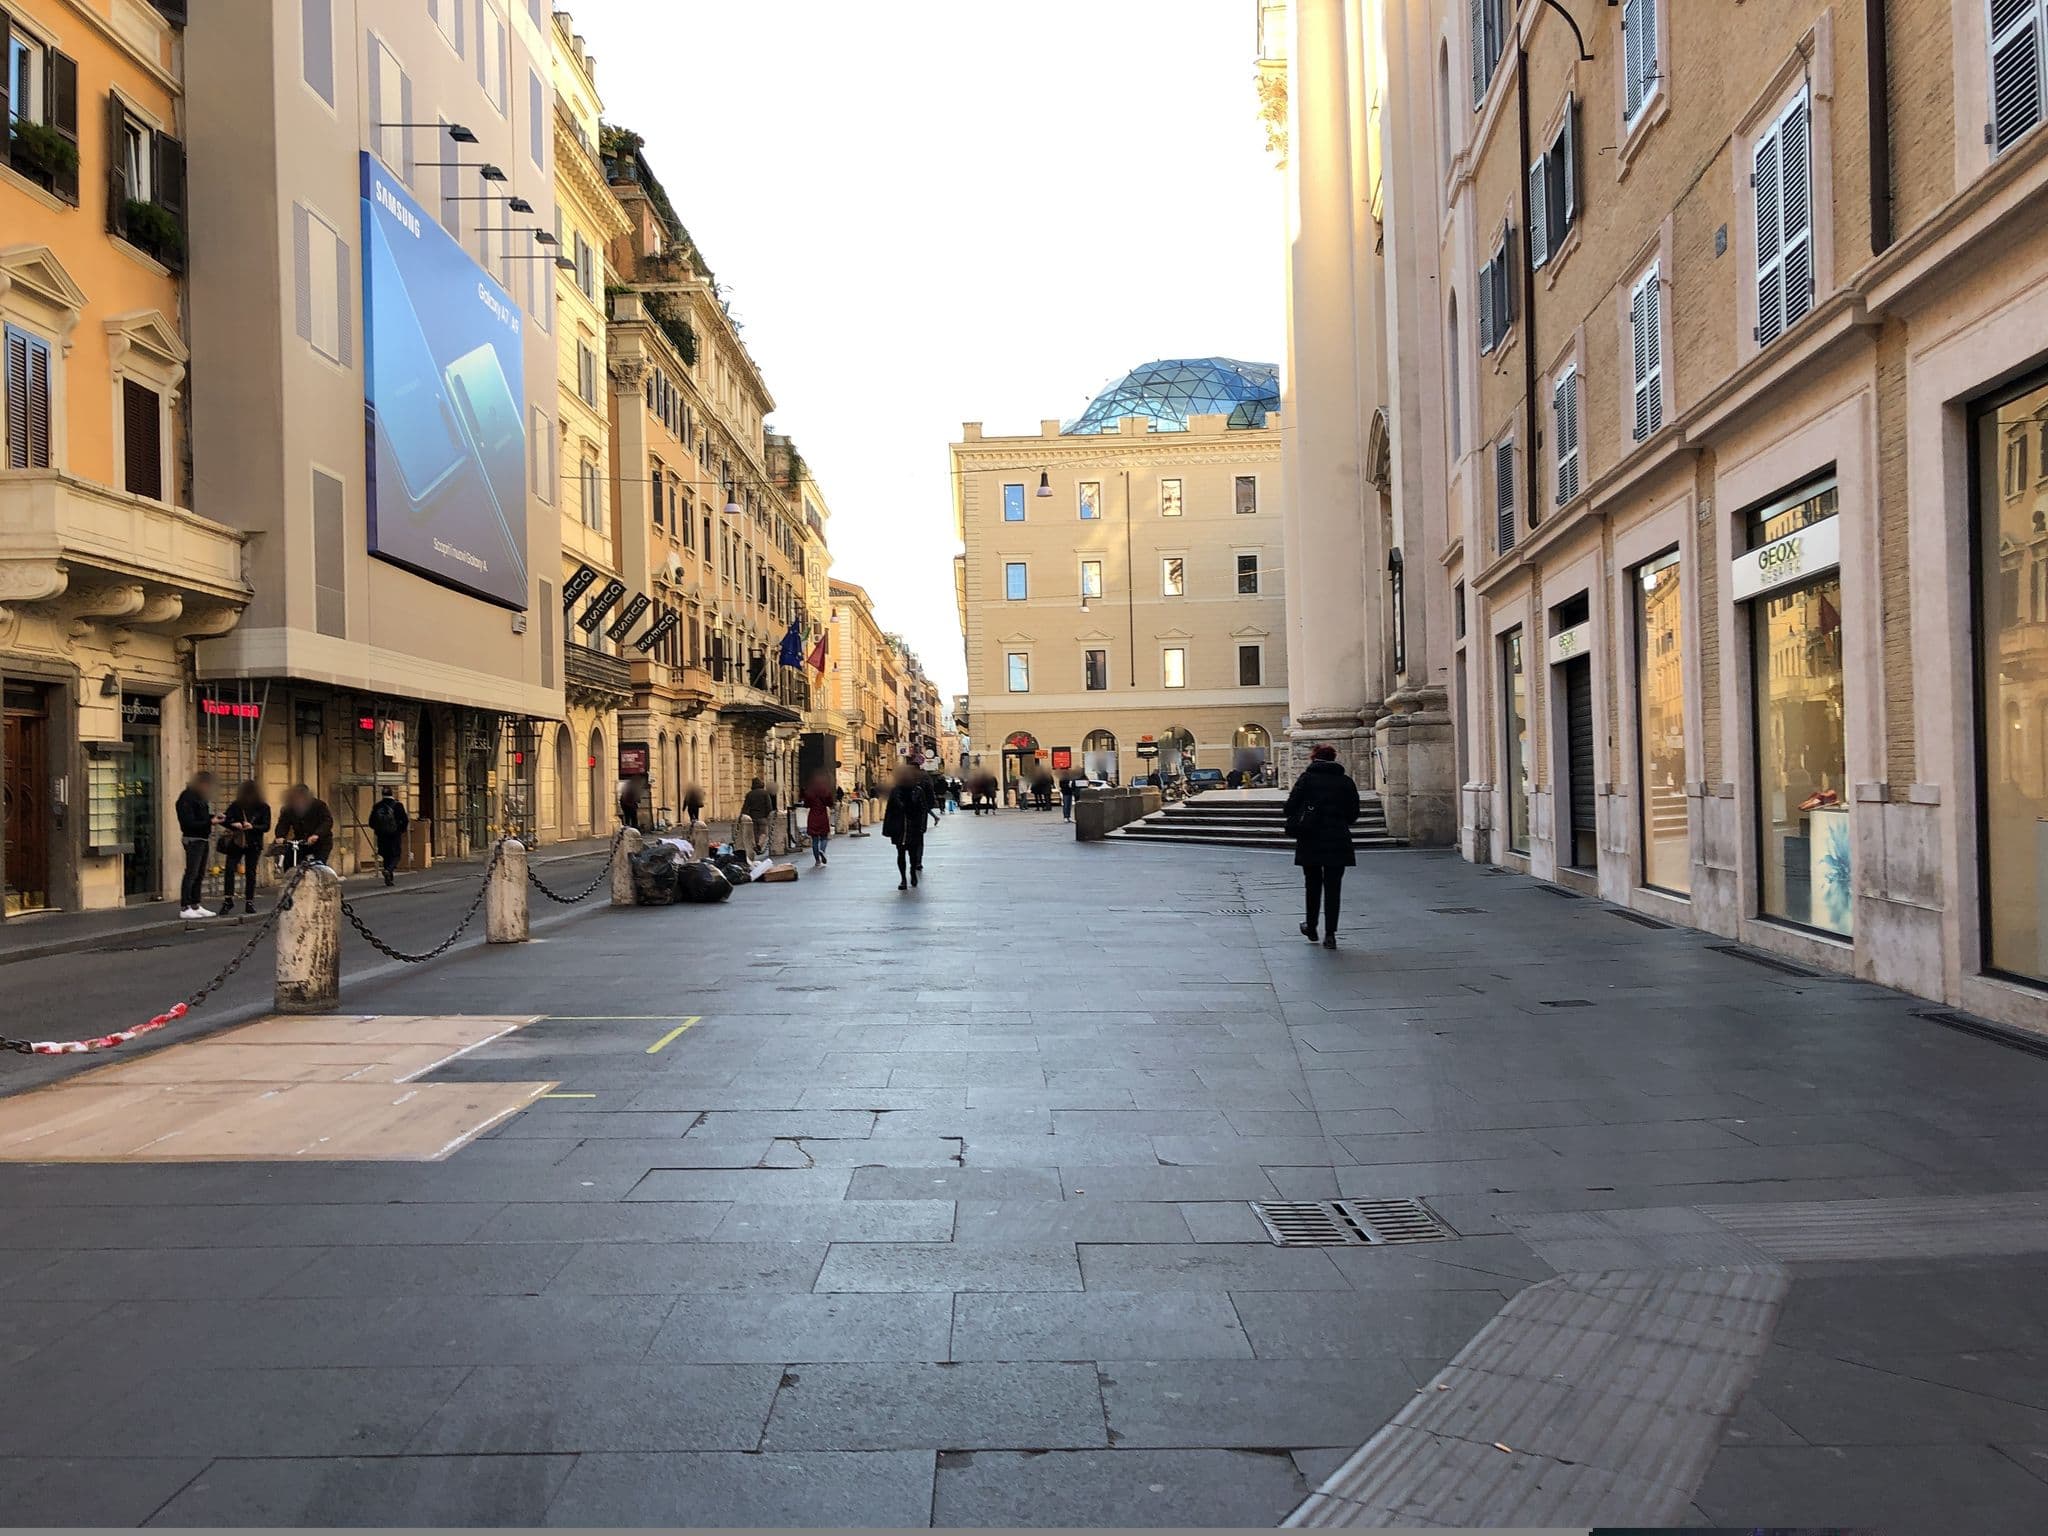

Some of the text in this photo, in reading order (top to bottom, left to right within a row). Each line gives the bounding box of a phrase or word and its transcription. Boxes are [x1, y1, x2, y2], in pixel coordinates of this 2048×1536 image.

[375, 180, 421, 239] SAMSUNG
[478, 282, 501, 321] Galaxy
[1758, 537, 1798, 569] GEOX
[583, 583, 622, 629] GUESS
[611, 597, 647, 639] GUESS
[637, 614, 676, 651] GUESS
